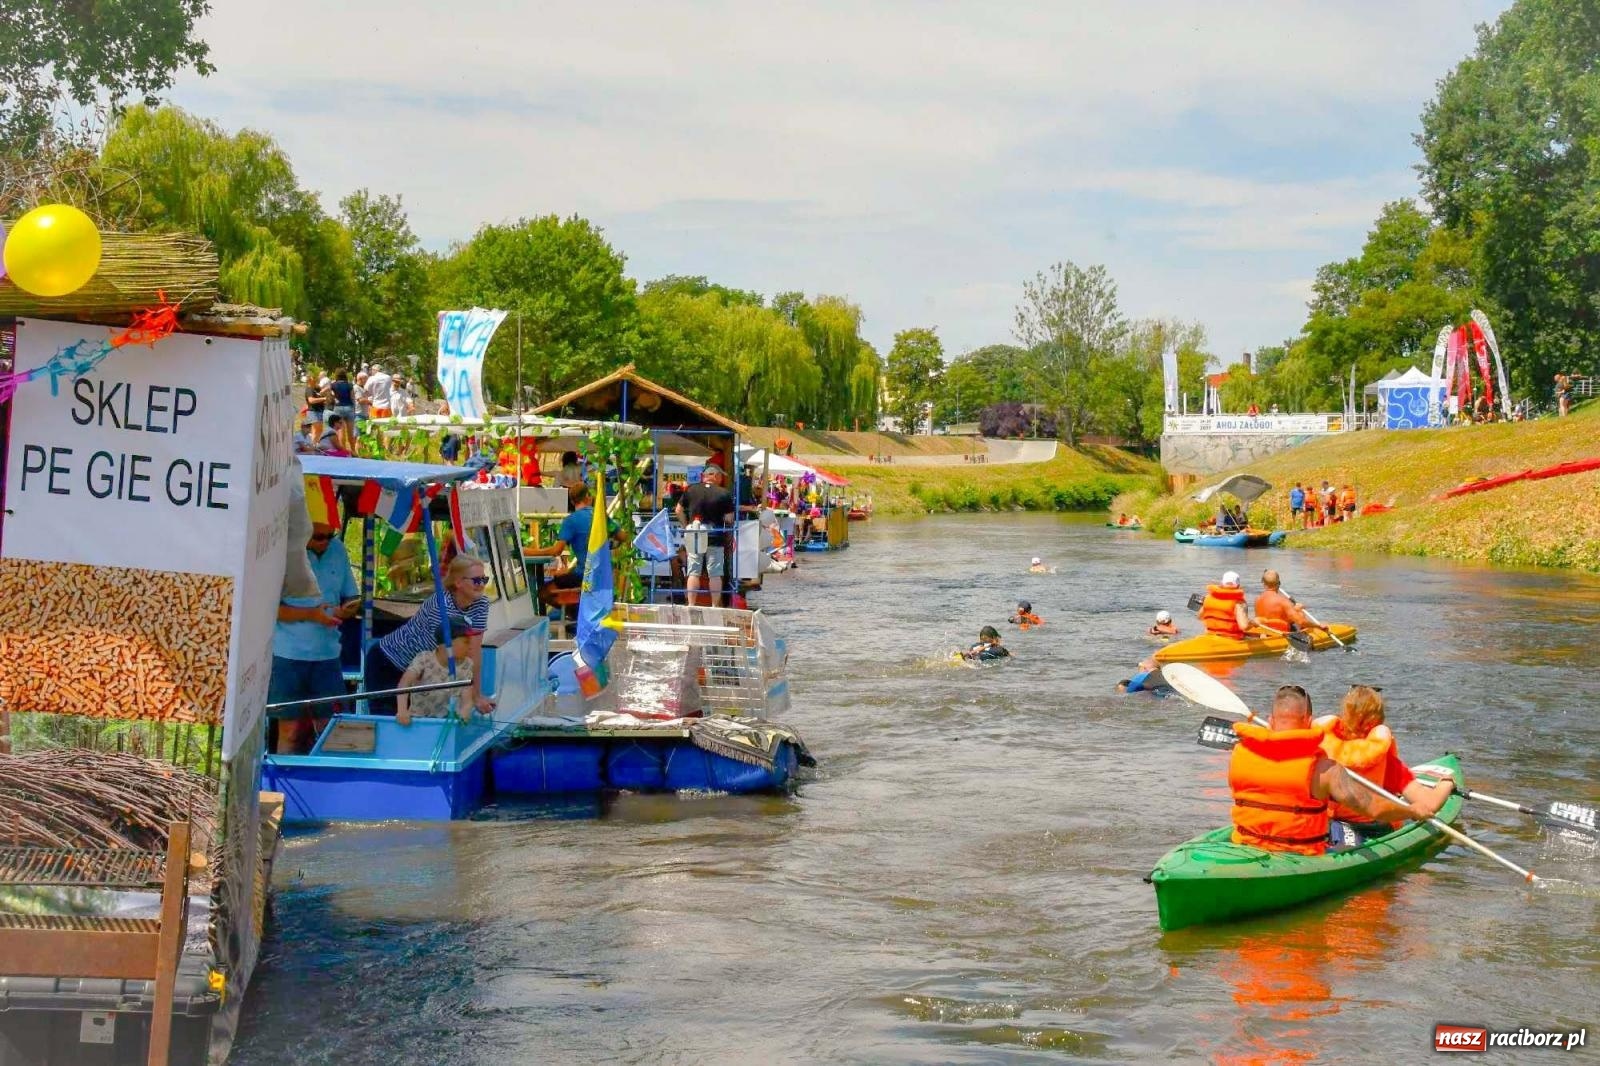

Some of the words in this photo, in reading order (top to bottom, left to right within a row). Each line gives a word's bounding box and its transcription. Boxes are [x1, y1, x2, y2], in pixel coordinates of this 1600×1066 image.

[71, 377, 198, 434] SKLEP
[1216, 420, 1237, 430] AHOJ
[20, 444, 73, 495] PE
[86, 450, 152, 502] GIE
[165, 458, 231, 510] GIE
